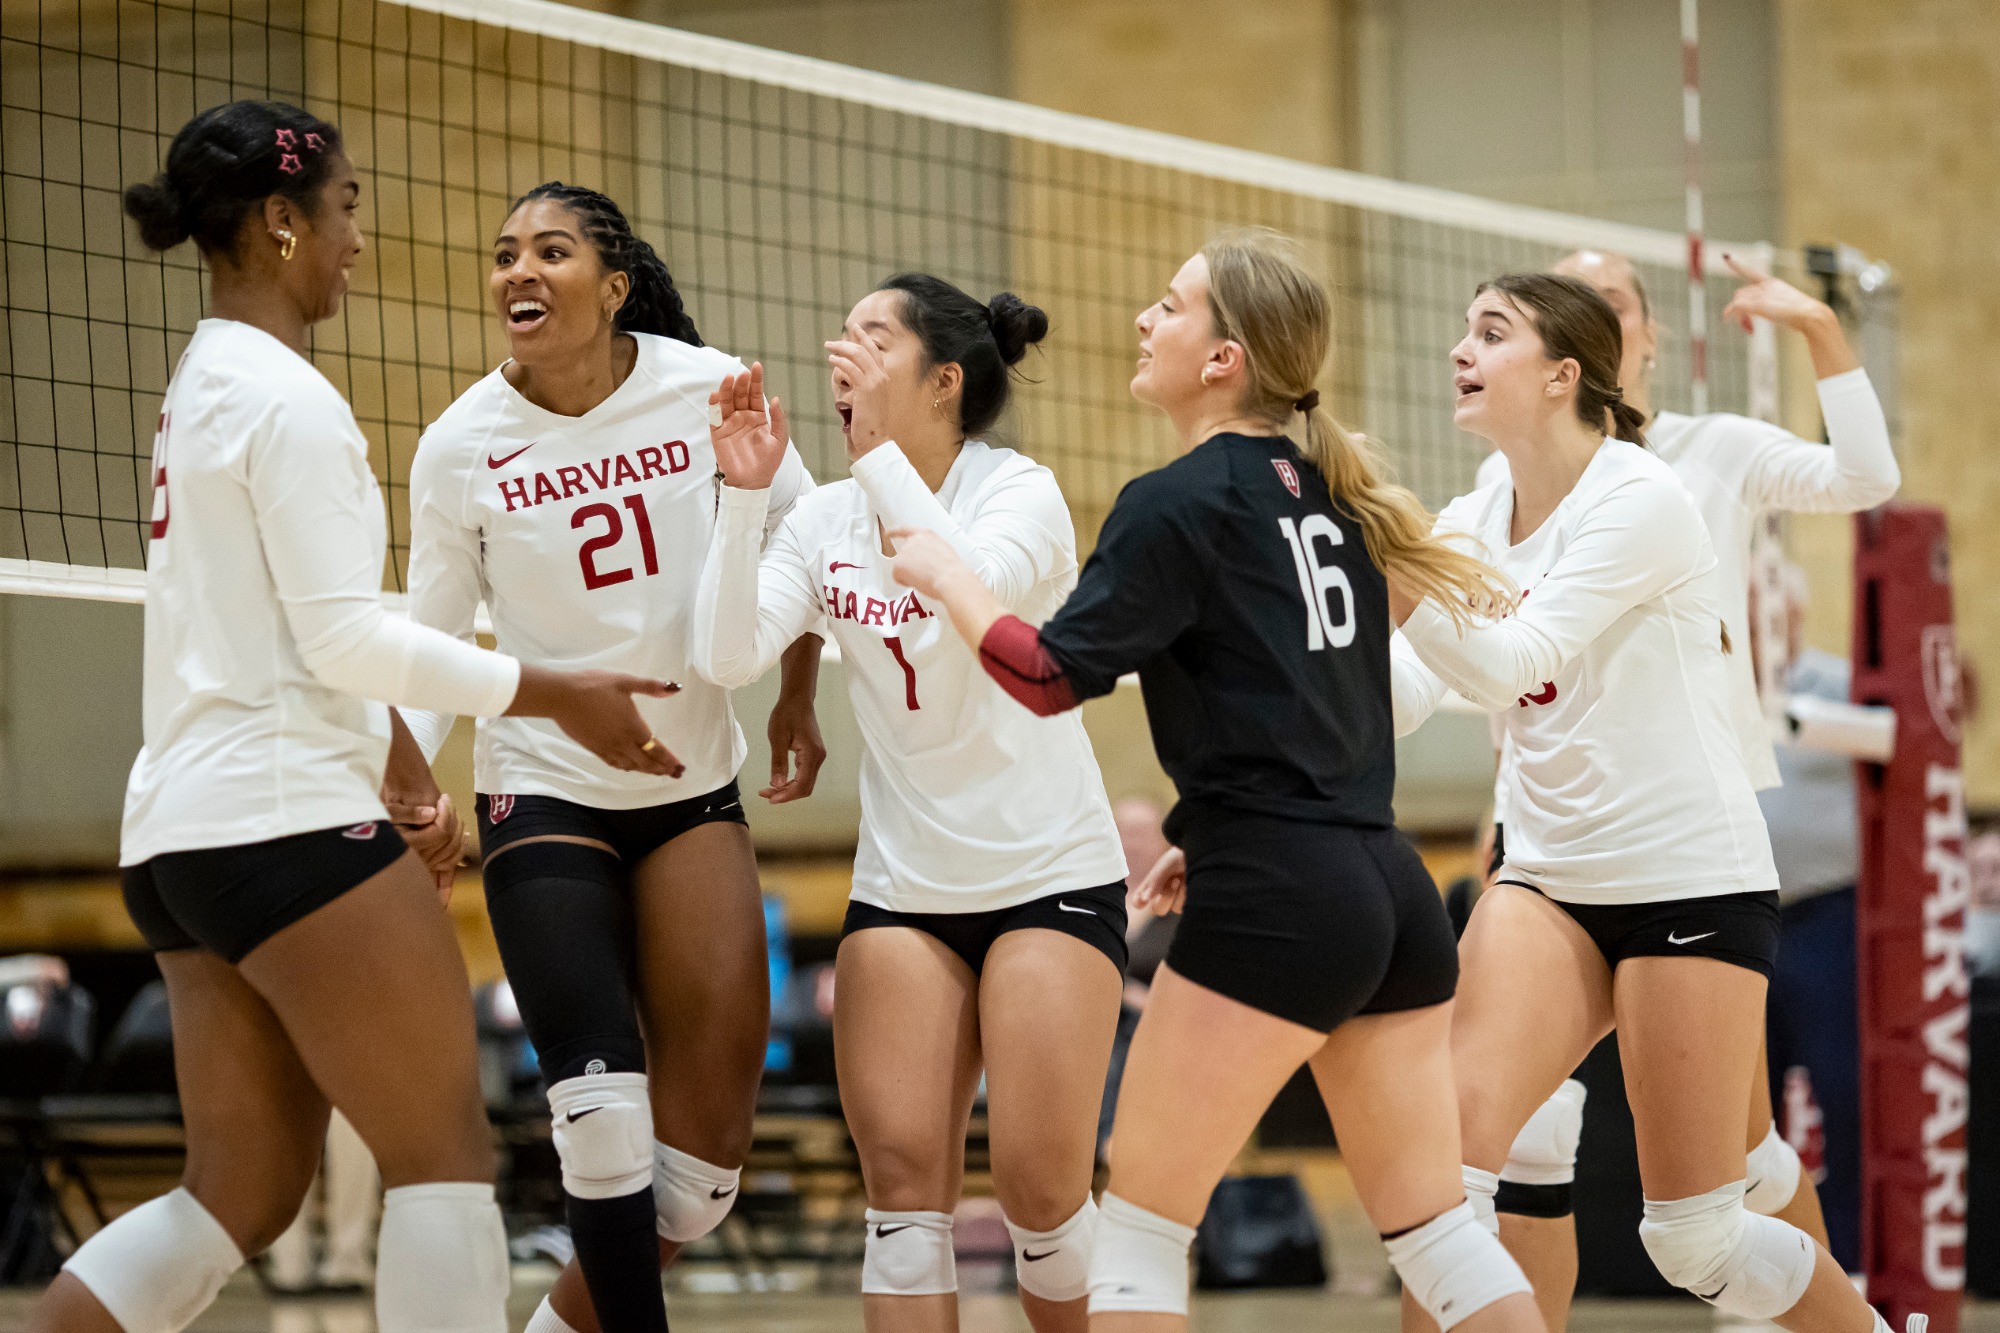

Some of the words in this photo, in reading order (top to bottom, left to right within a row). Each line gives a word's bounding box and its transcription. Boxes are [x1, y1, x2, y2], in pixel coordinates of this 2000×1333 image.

[497, 439, 691, 513] HARVARD
[570, 493, 660, 591] 21
[822, 584, 935, 627] HARVA
[1277, 513, 1356, 652] 16
[882, 636, 922, 712] 1
